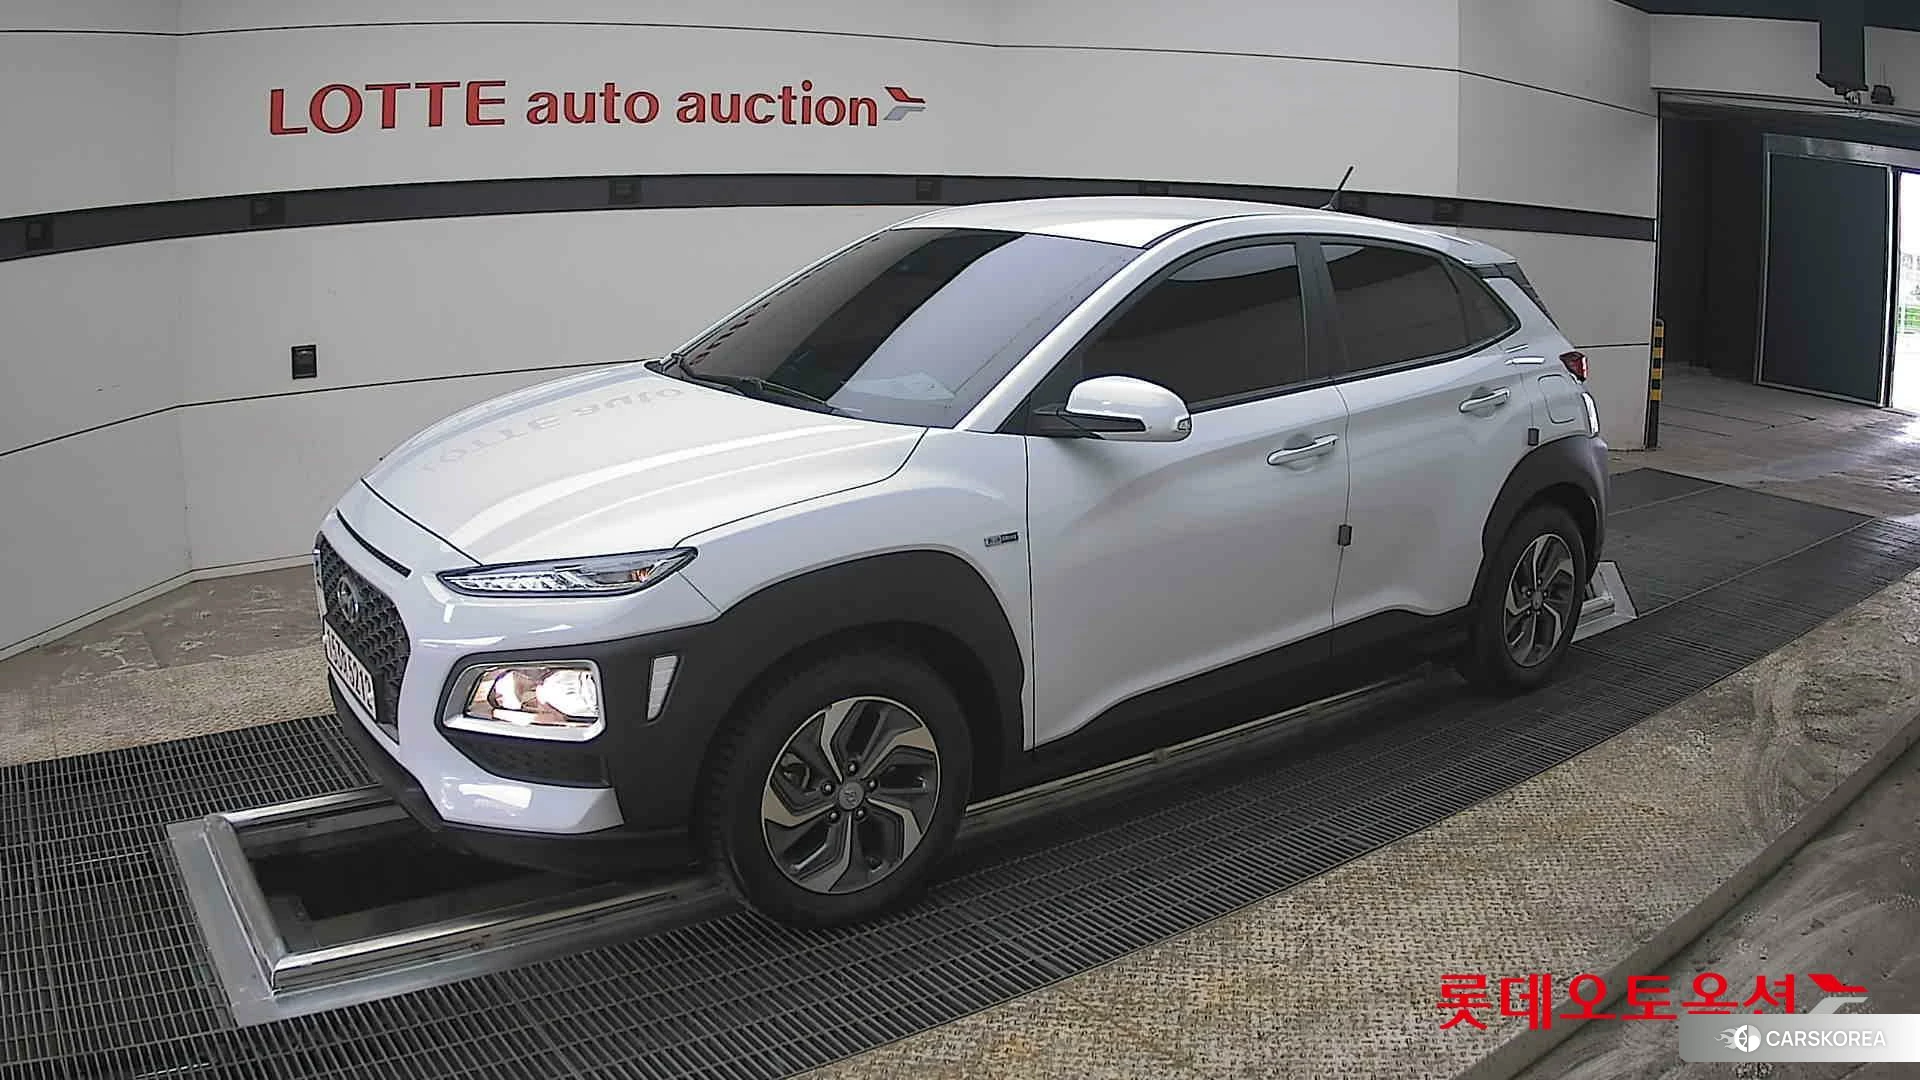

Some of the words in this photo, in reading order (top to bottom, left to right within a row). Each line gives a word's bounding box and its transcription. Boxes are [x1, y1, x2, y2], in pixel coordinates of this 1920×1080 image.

[269, 80, 506, 135] LOTTE
[526, 82, 660, 125] auto
[676, 80, 878, 126] auction
